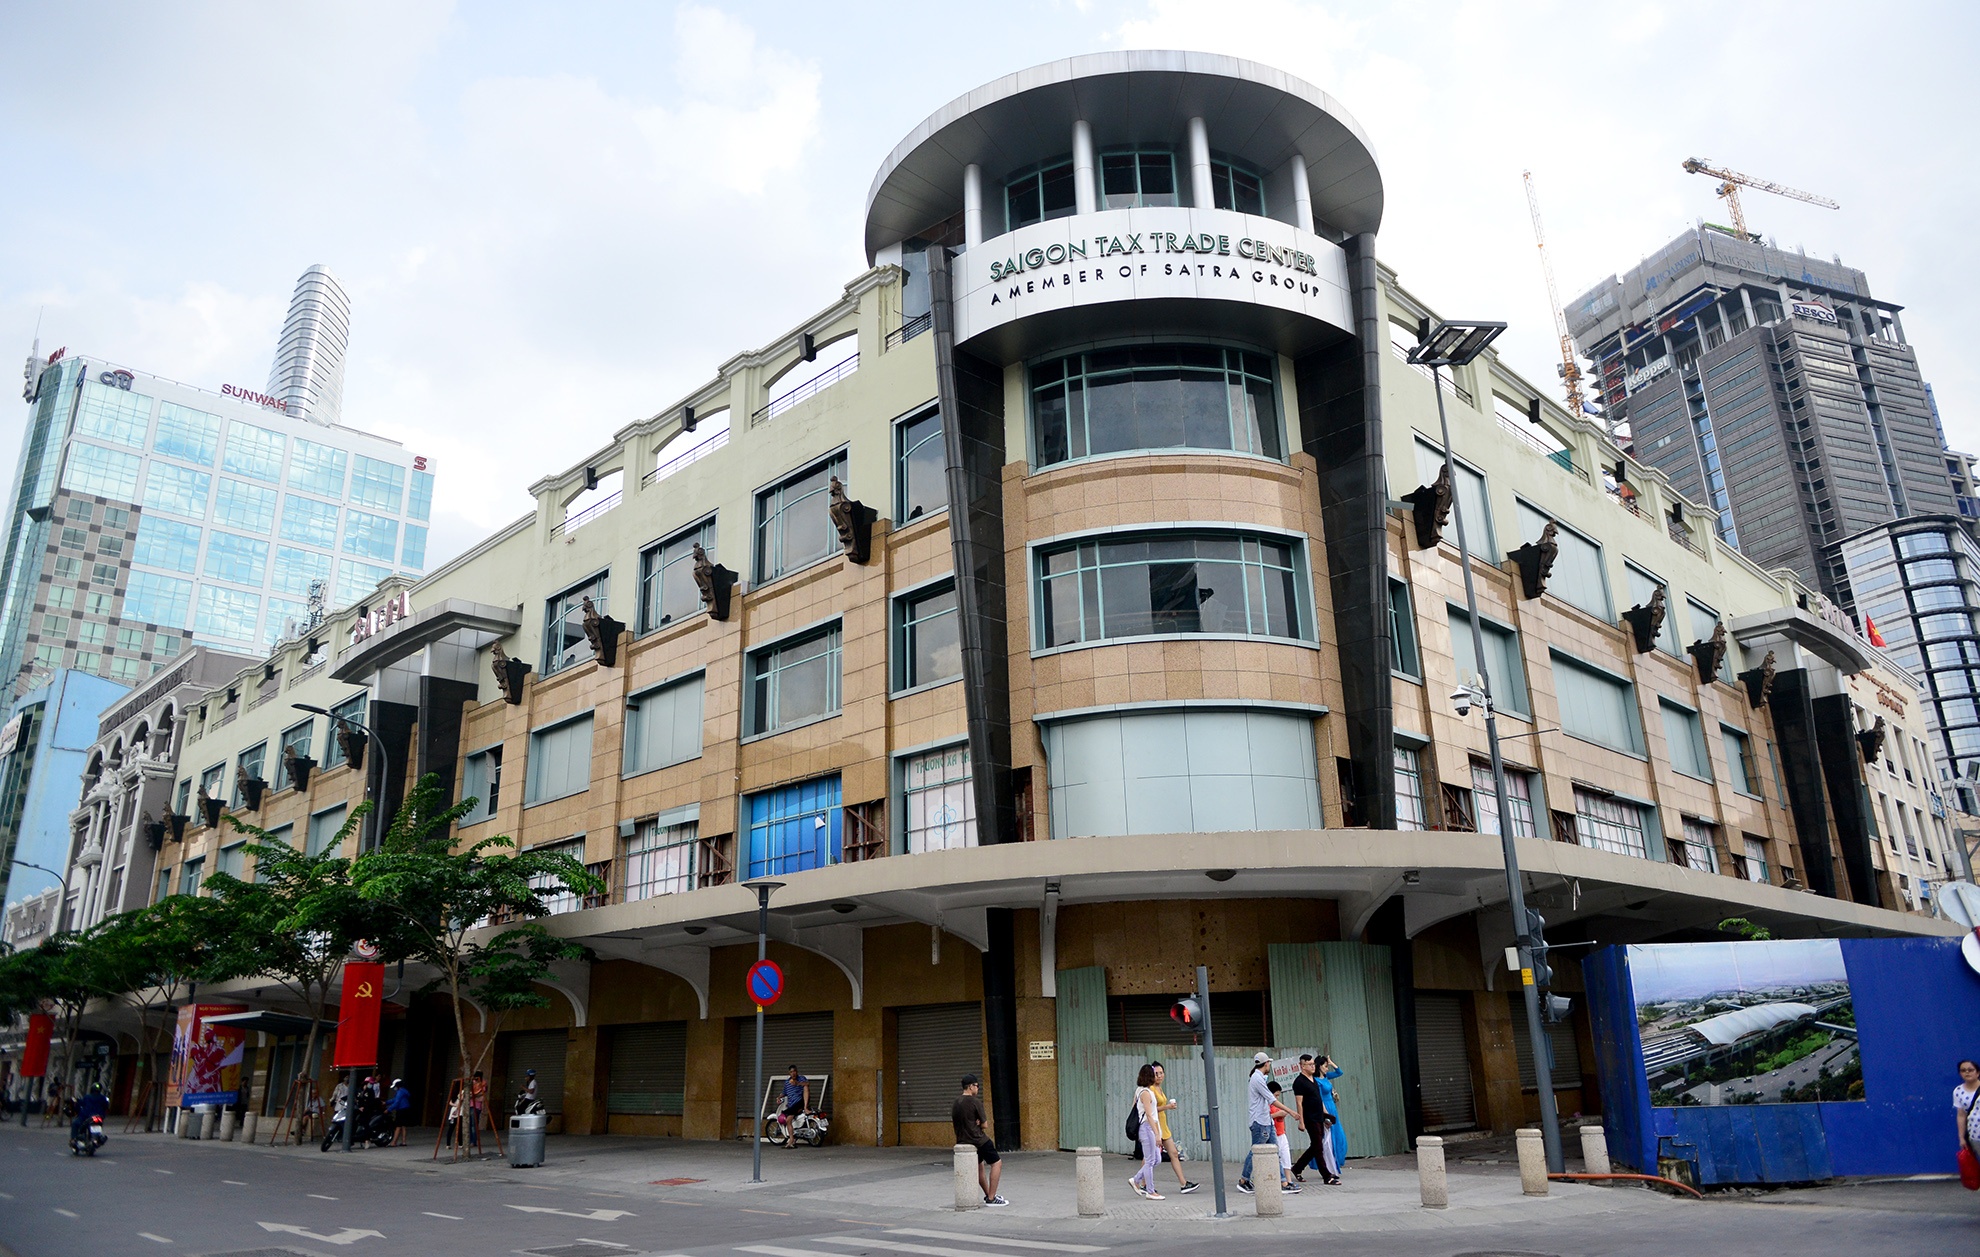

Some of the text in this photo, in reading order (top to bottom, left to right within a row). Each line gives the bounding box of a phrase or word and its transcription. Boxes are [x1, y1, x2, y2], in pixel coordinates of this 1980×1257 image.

[990, 232, 1317, 282] SAIGON TAX TRADE CENTER
[991, 263, 1320, 306] A MEMBER OF SATRA GROUP
[1793, 303, 1836, 322] RESCO
[99, 370, 135, 391] citi
[1629, 357, 1668, 388] Keppel
[221, 383, 288, 412] SUNWAH
[354, 590, 410, 645] SATRA
